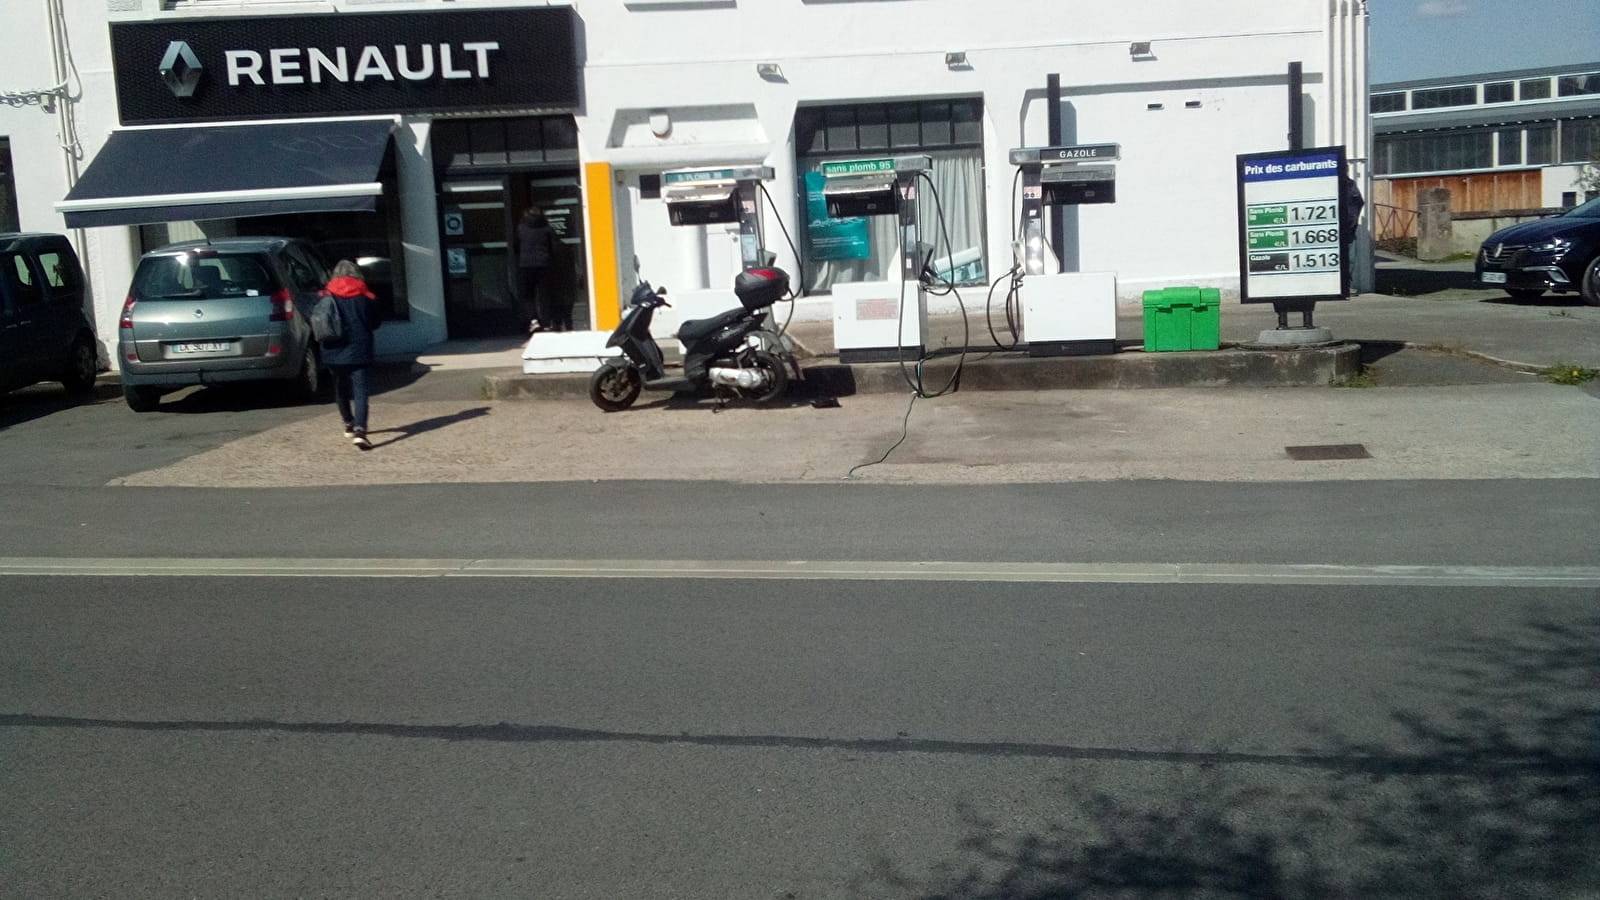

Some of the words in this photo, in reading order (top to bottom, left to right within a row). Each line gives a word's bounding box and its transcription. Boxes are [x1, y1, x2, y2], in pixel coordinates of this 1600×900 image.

[224, 41, 500, 86] RENAULT
[1059, 149, 1097, 158] GAZOLE
[849, 163, 876, 173] plomb
[879, 161, 891, 169] 95
[1245, 165, 1264, 175] Prix
[1265, 163, 1283, 173] des
[1285, 160, 1338, 172] carburants
[1291, 205, 1337, 220] 1.721
[1292, 229, 1338, 245] 1.668
[1293, 253, 1339, 268] 1.513
